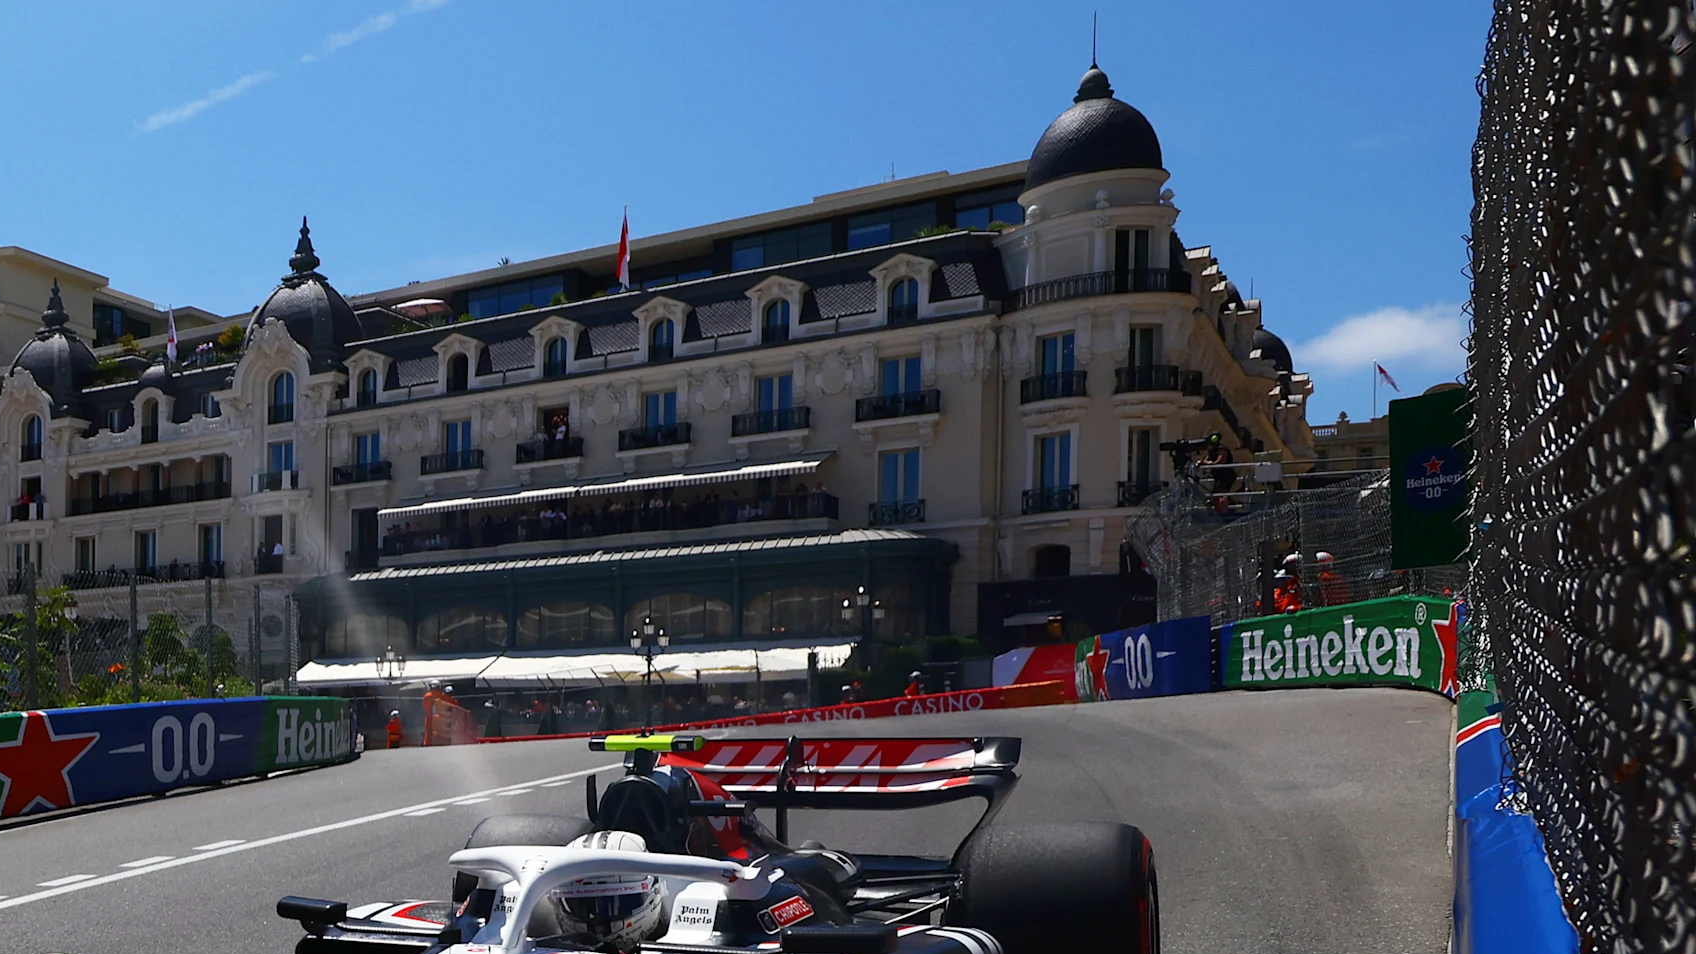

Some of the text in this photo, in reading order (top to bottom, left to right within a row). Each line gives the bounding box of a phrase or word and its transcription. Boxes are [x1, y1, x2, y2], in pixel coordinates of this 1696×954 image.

[1406, 474, 1461, 489] Heineken
[1425, 487, 1442, 499] 0.0
[1240, 614, 1422, 682] Heineken
[1124, 633, 1153, 690] 0.0
[894, 692, 984, 716] CASINO
[152, 711, 215, 783] 0.0
[499, 896, 517, 904] Pal
[680, 905, 710, 915] Palm
[774, 900, 810, 923] CHIPOTLE
[674, 915, 713, 925] Angels
